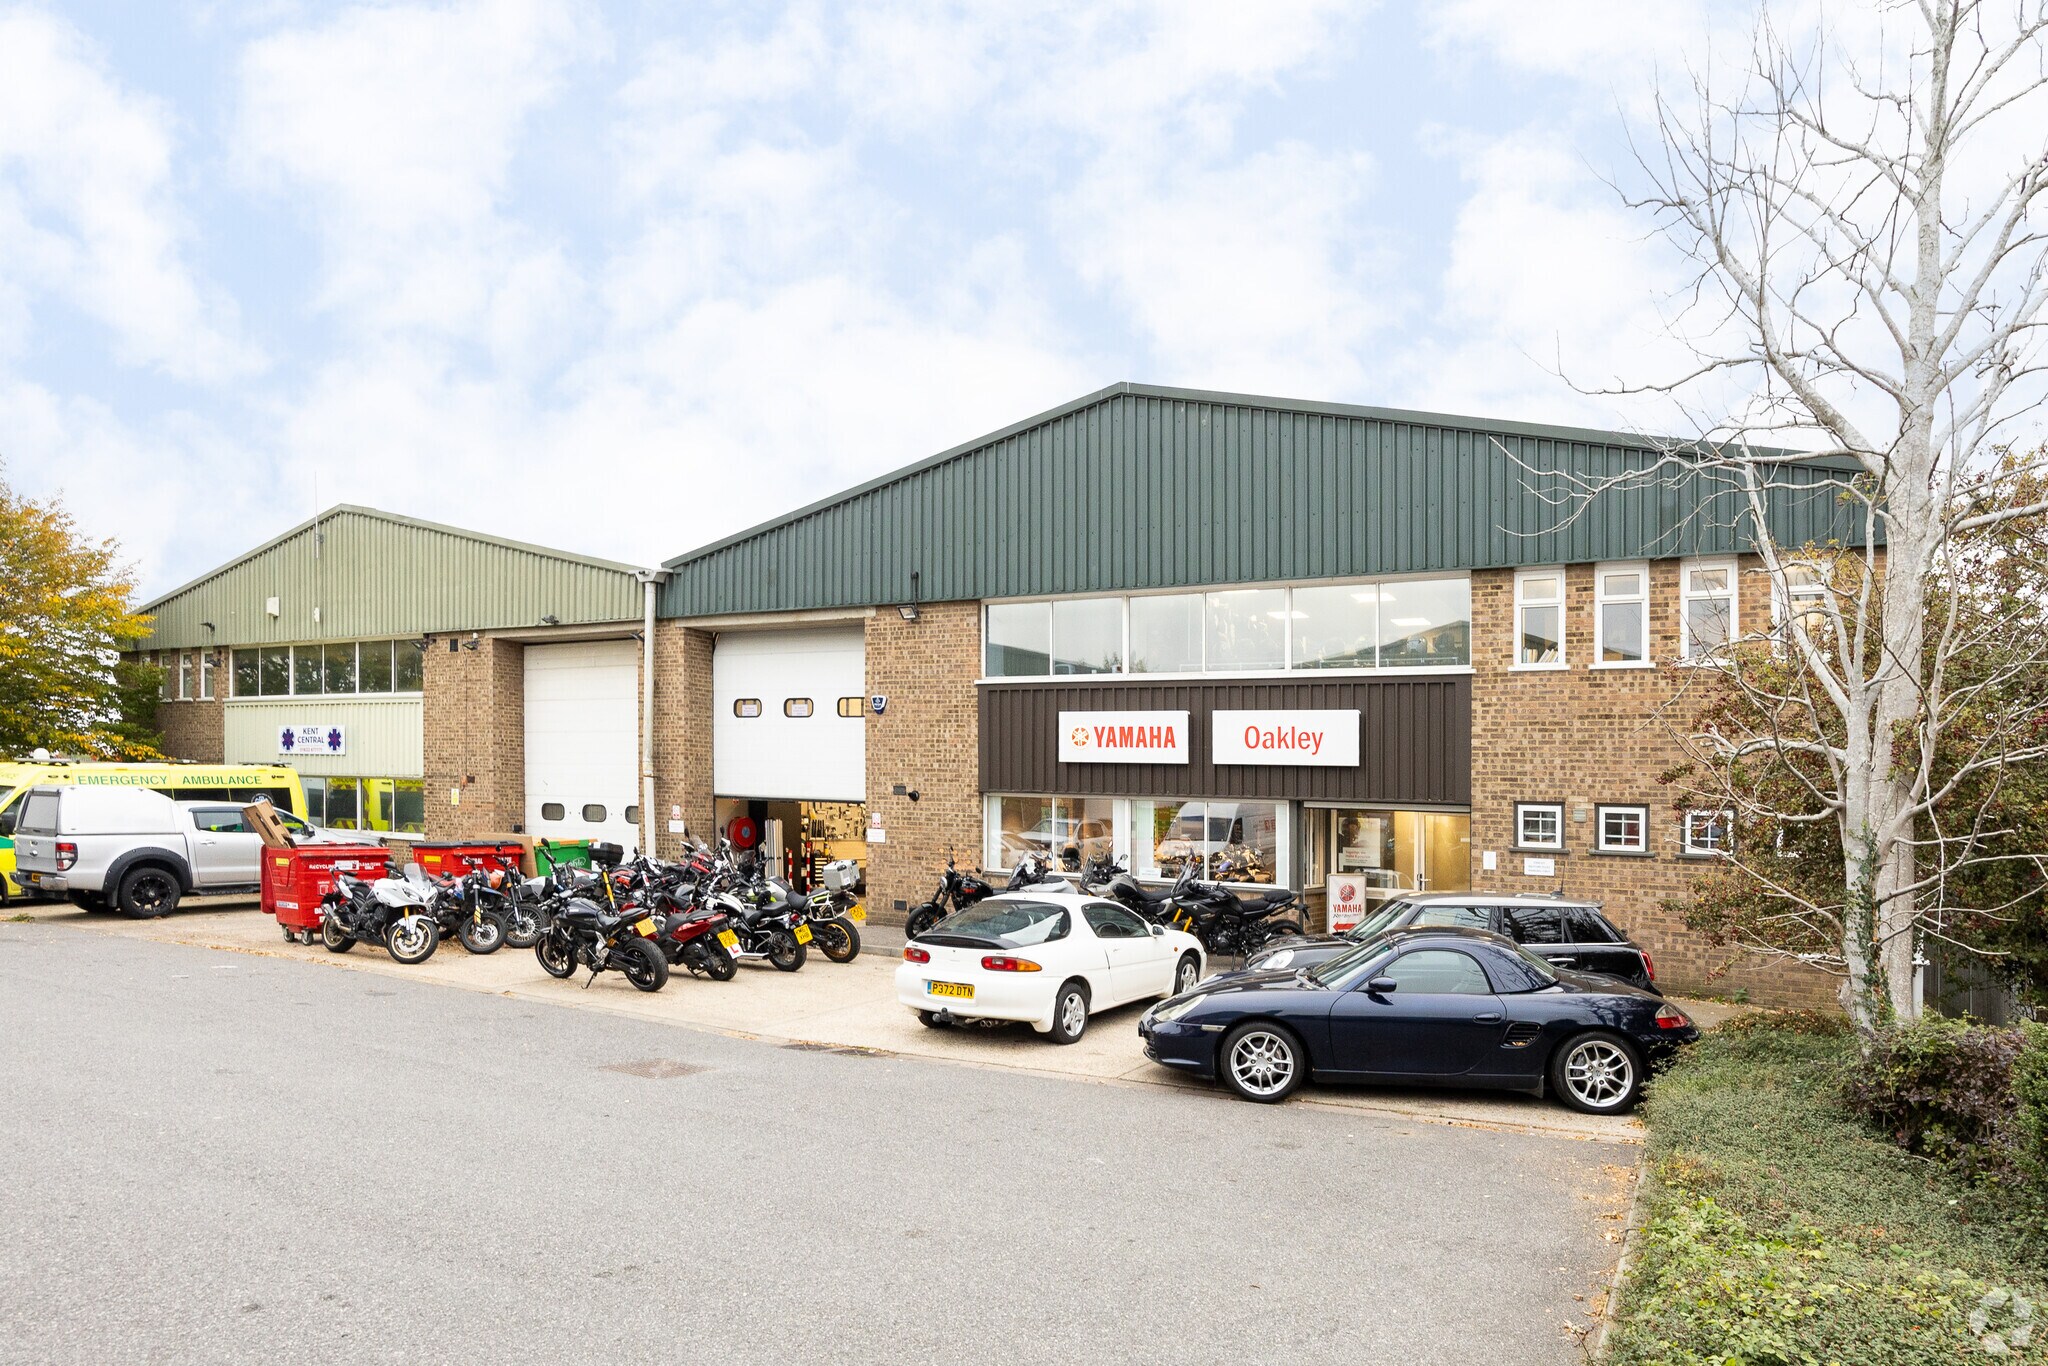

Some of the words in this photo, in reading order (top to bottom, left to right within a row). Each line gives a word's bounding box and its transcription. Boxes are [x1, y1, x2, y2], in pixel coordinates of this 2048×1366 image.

[297, 736, 325, 744] CENTRAL
[1094, 726, 1176, 748] YAMAHA
[1244, 725, 1324, 755] Oakley
[78, 775, 167, 785] EMERGENCY
[182, 775, 262, 785] AMBULANCE
[1333, 904, 1362, 912] YAMAHA
[932, 984, 955, 995] P372
[956, 986, 974, 997] DTN
